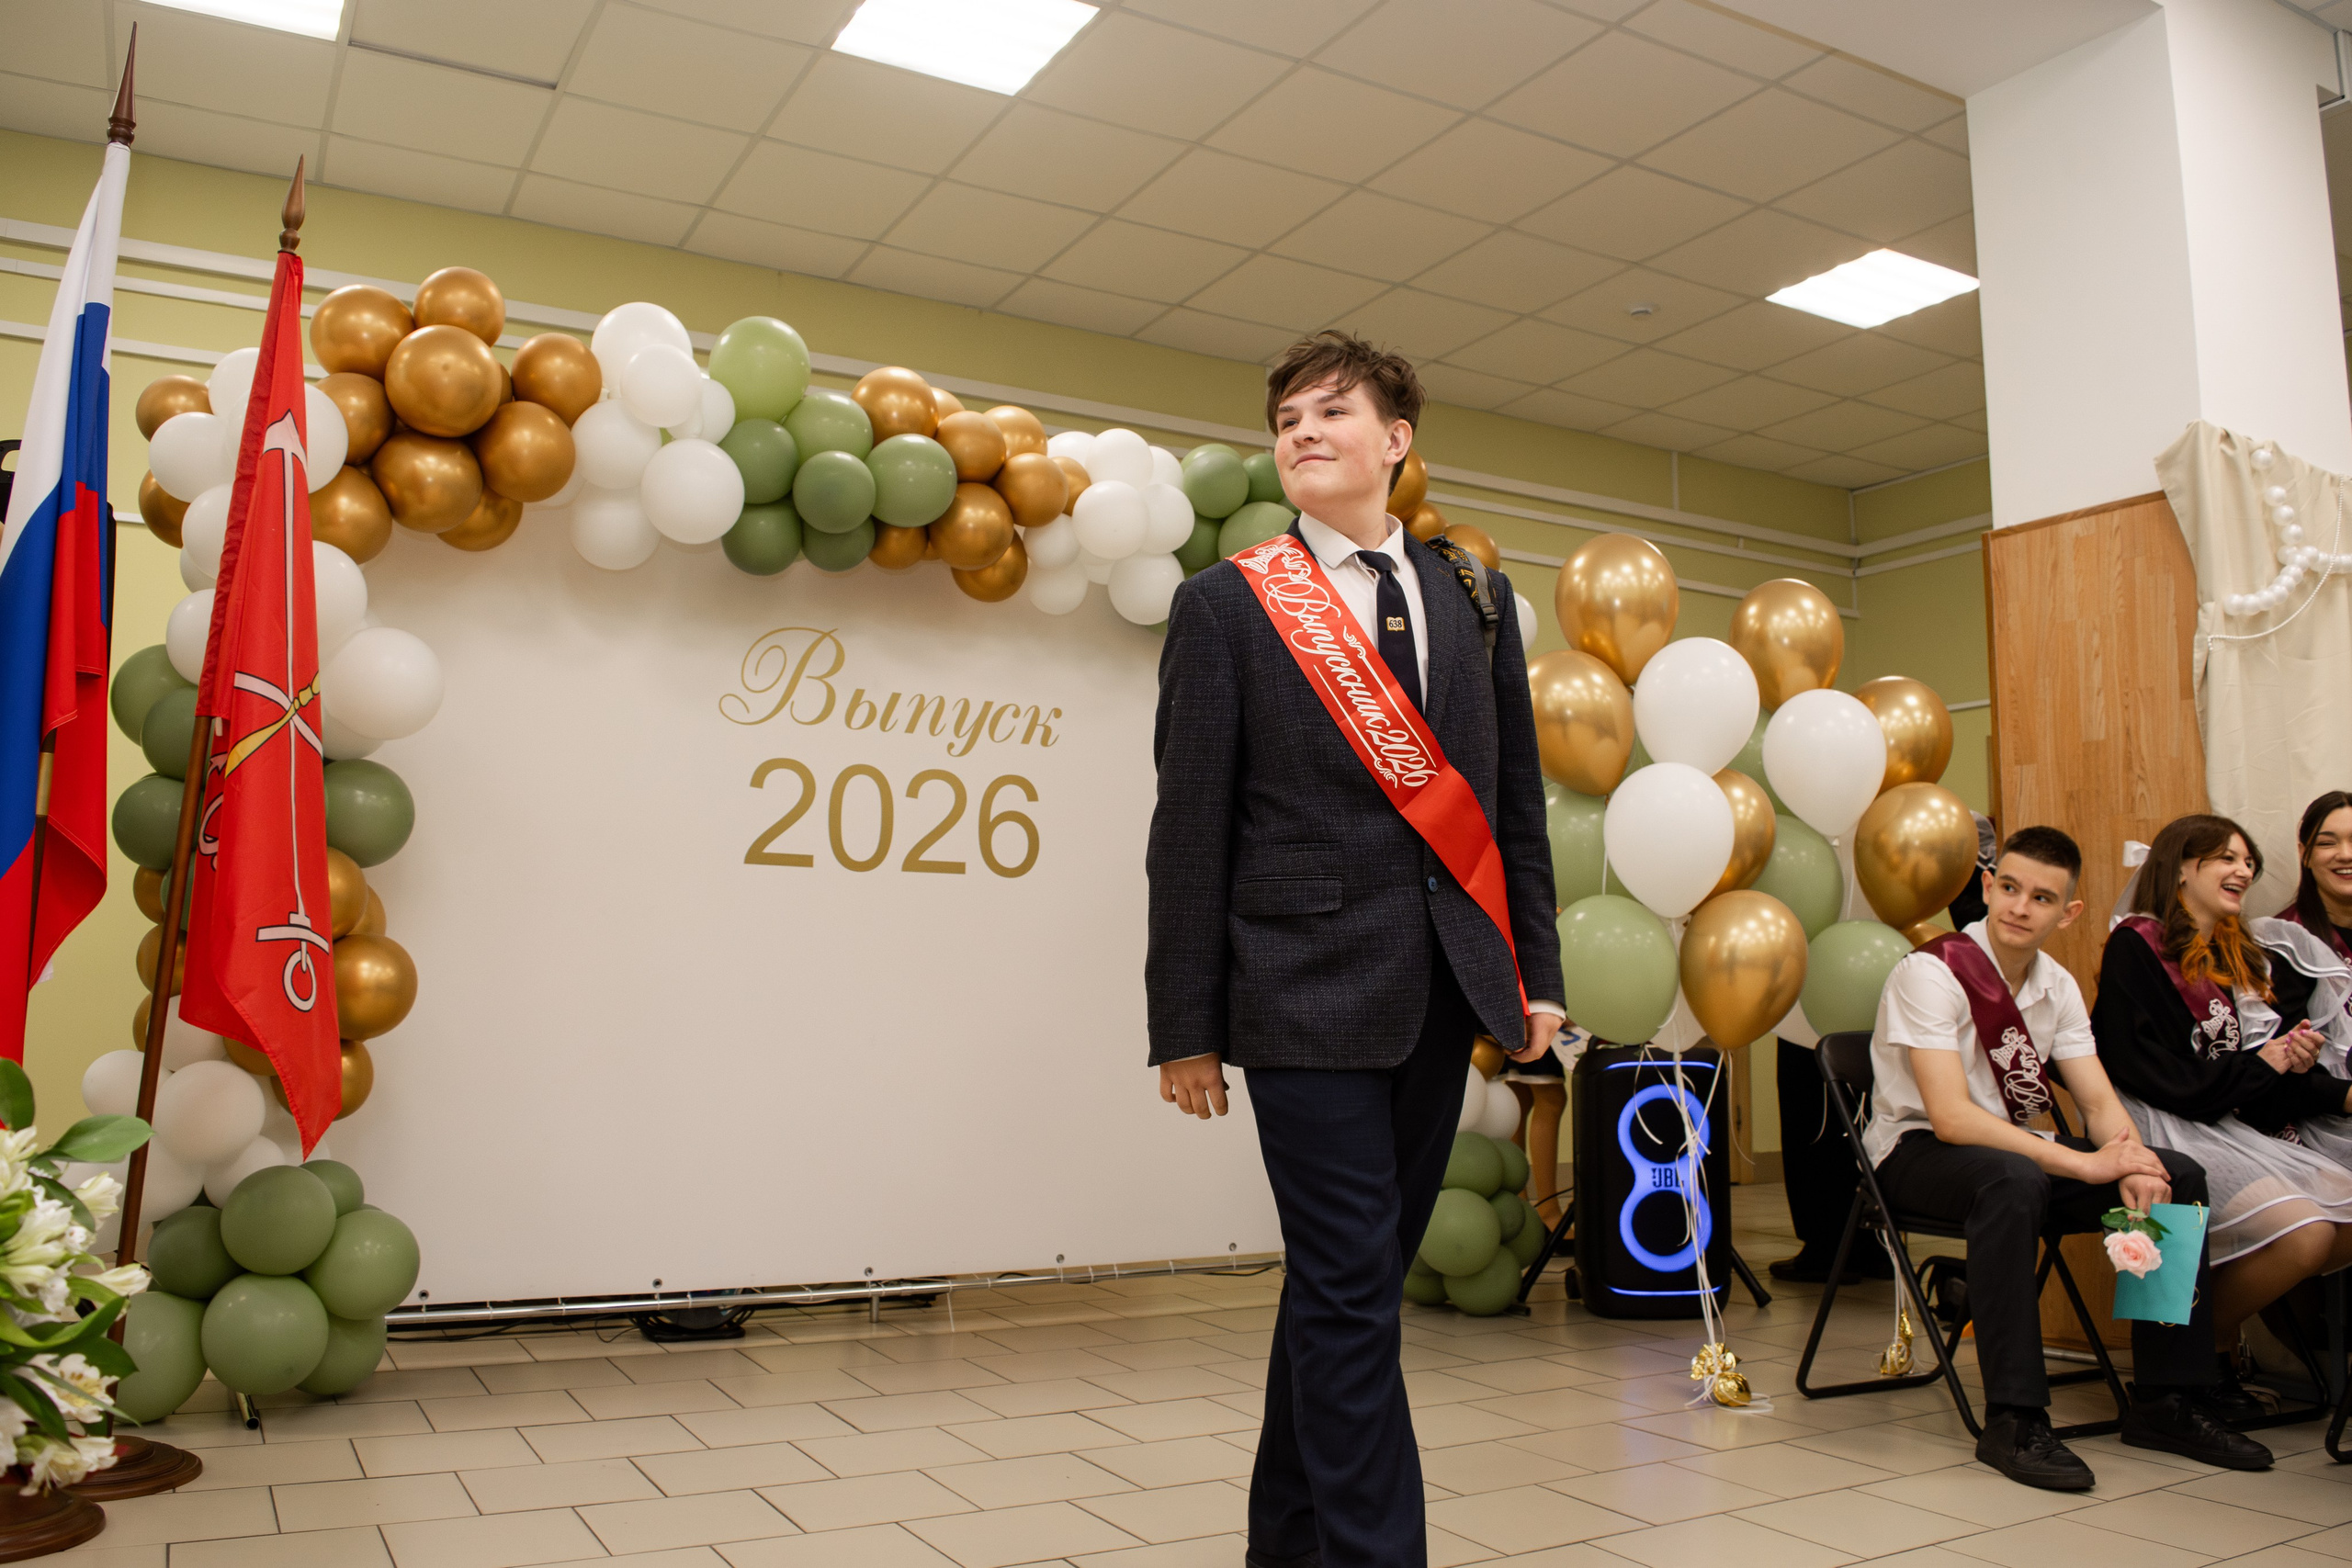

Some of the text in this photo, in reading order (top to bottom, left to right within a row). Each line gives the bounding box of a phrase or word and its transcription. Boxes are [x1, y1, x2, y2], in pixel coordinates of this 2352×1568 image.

[1261, 573, 1440, 787] Выпускник 2026
[1388, 619, 1403, 628] 638
[718, 626, 1063, 758] Выпуск
[743, 757, 1041, 878] 2026
[1651, 1168, 1684, 1188] JBL
